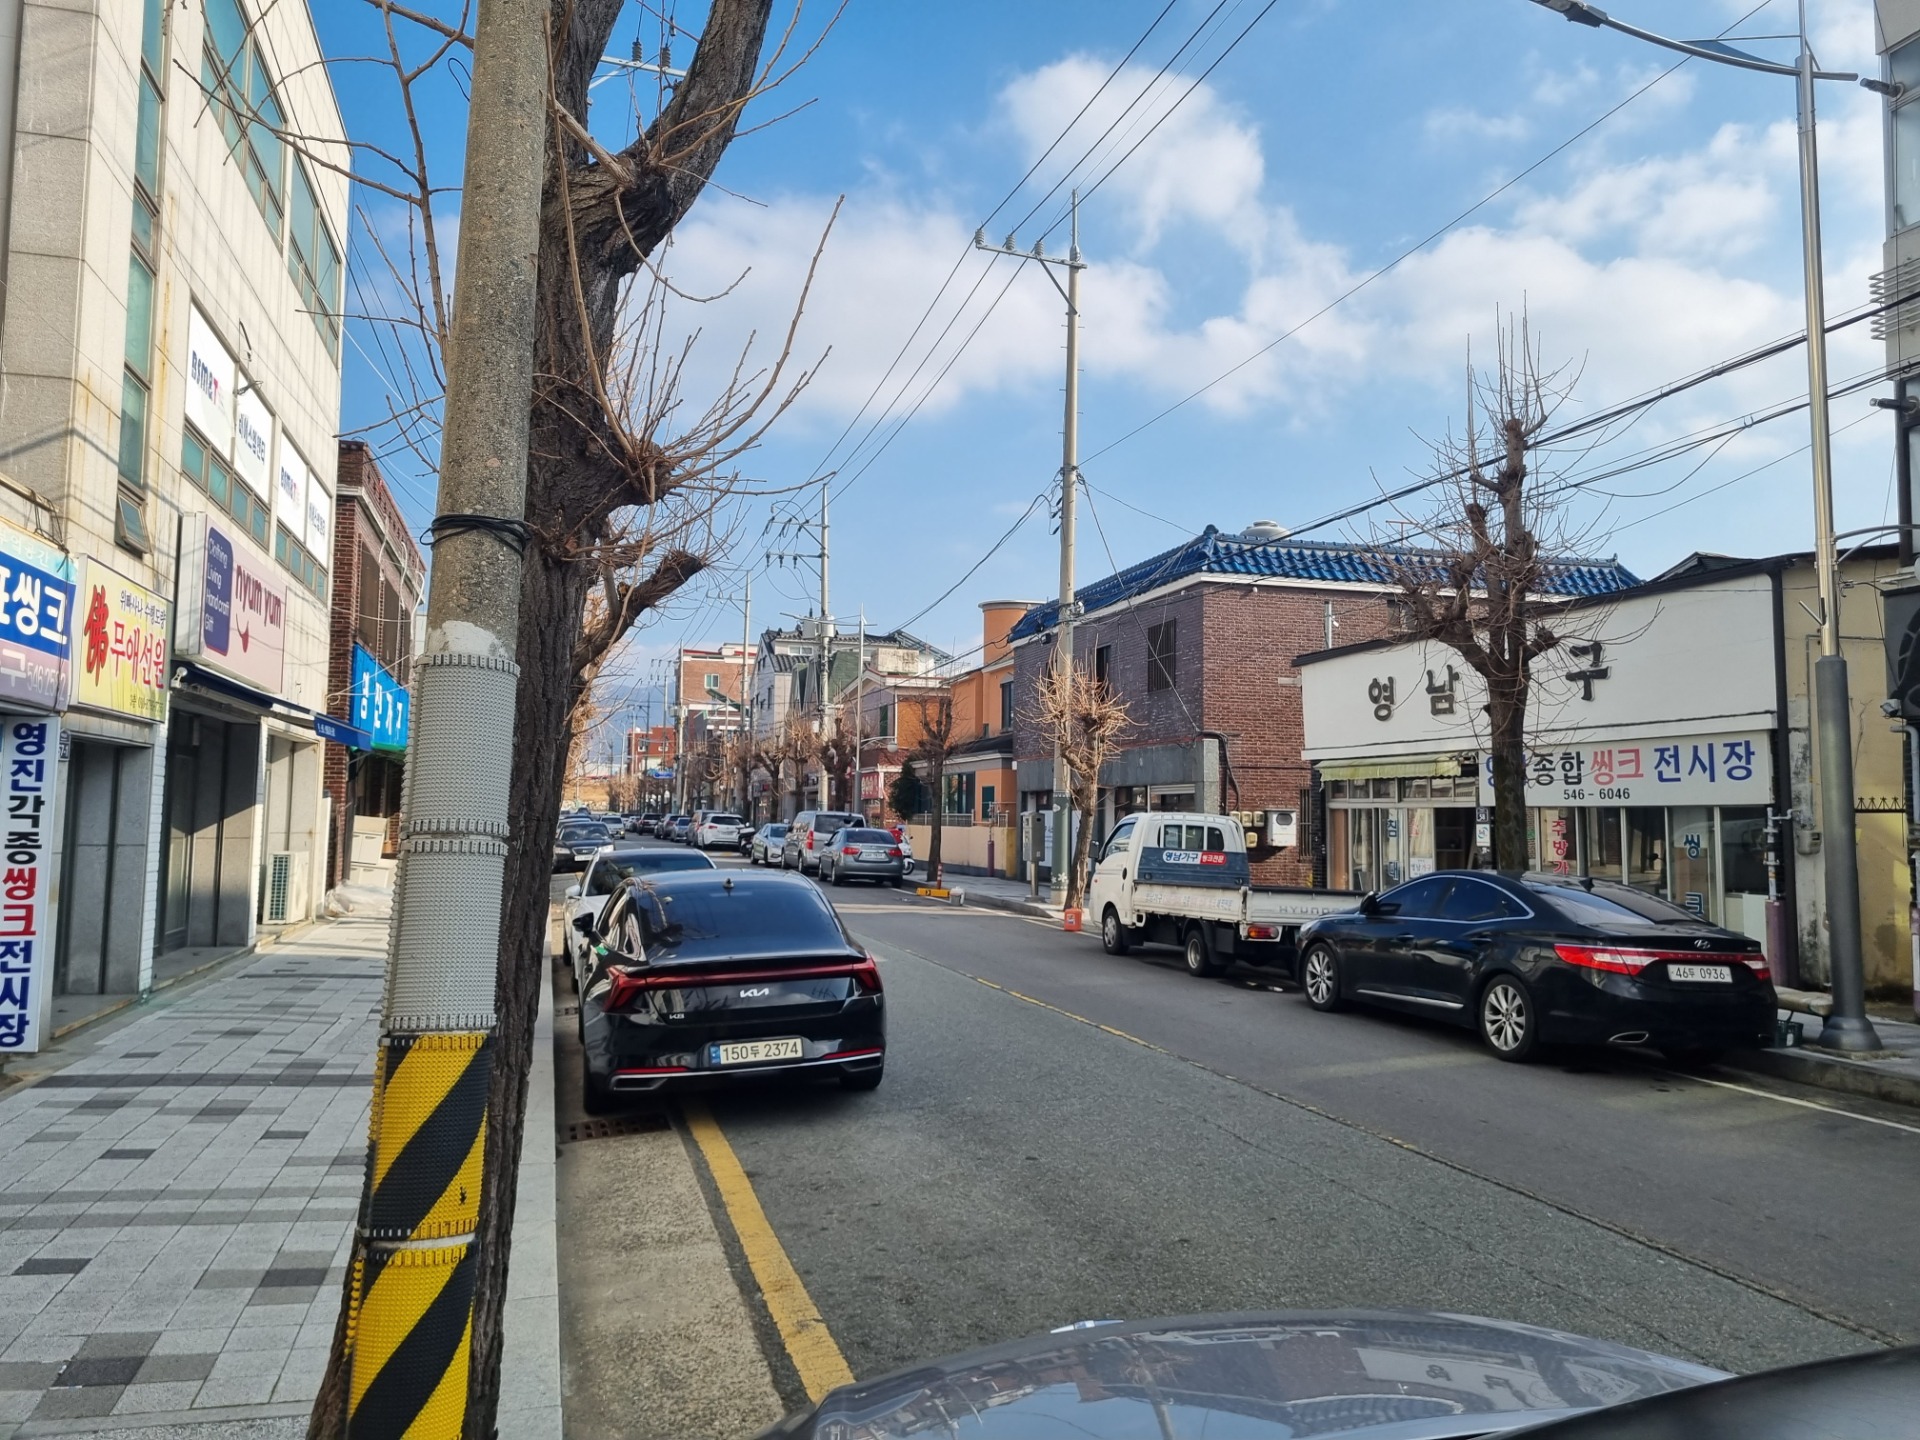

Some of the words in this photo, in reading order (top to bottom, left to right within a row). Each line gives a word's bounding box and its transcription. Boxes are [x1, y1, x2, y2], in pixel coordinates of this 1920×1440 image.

[208, 537, 228, 569] Clothing
[207, 563, 222, 589] Living
[236, 563, 262, 616] nyum
[264, 587, 281, 630] yum
[110, 620, 167, 690] 무애선원
[1653, 740, 1756, 783] 전시장
[1164, 851, 1199, 862] 영남가구
[1699, 967, 1726, 980] 0936
[722, 1044, 760, 1062] 150두
[763, 1041, 798, 1058] 2374
